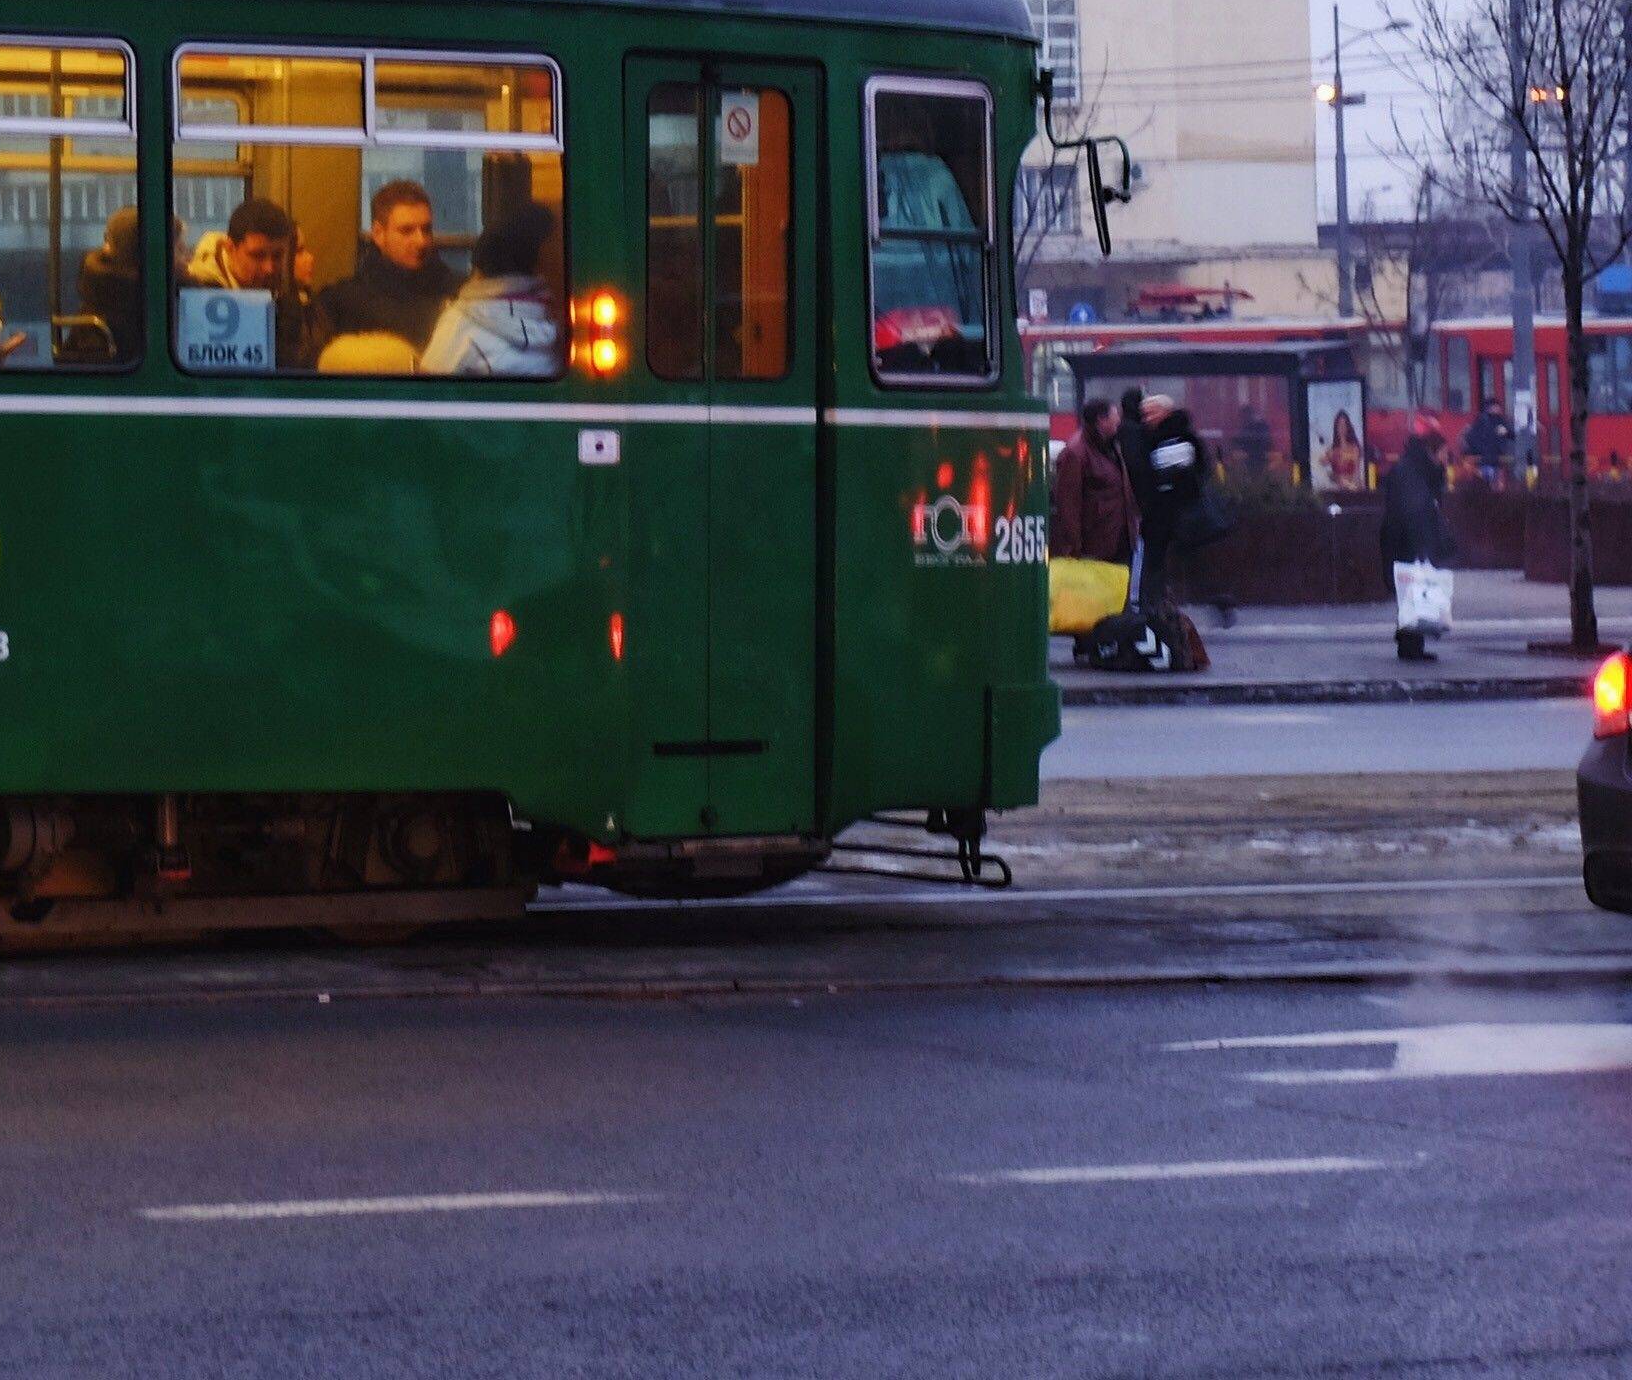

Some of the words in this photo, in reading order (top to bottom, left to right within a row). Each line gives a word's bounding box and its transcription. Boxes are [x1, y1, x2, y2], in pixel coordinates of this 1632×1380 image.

[204, 295, 241, 341] 9
[187, 344, 236, 364] БЛОК
[240, 345, 264, 364] 45
[994, 514, 1047, 565] 2655
